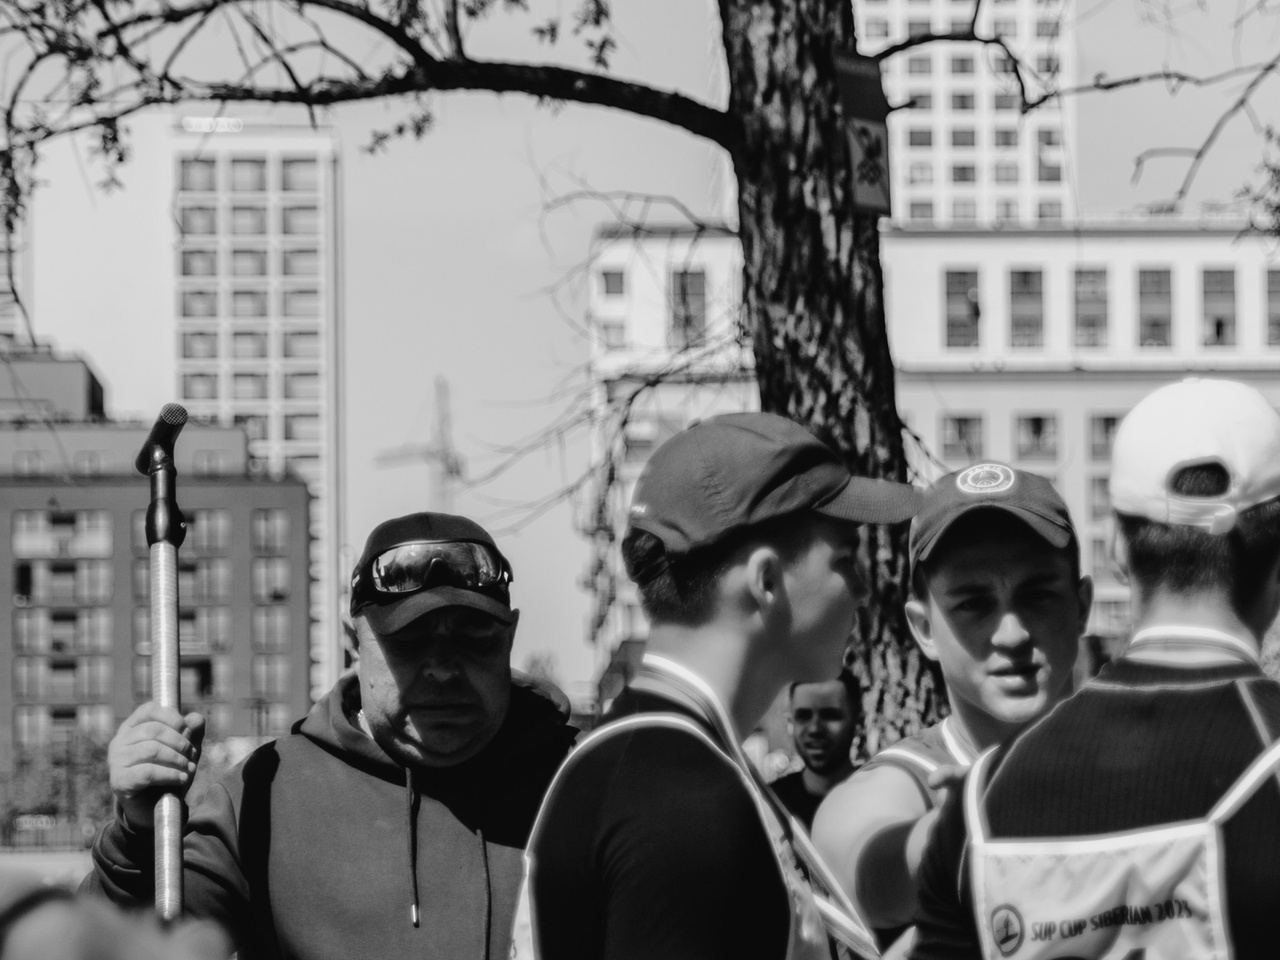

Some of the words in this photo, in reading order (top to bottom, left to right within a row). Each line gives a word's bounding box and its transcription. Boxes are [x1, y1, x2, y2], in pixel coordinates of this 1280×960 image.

[1031, 920, 1056, 942] SUP
[1059, 918, 1087, 939] CUP
[1090, 905, 1153, 931] SIBERIAN
[1154, 899, 1193, 921] 2023
